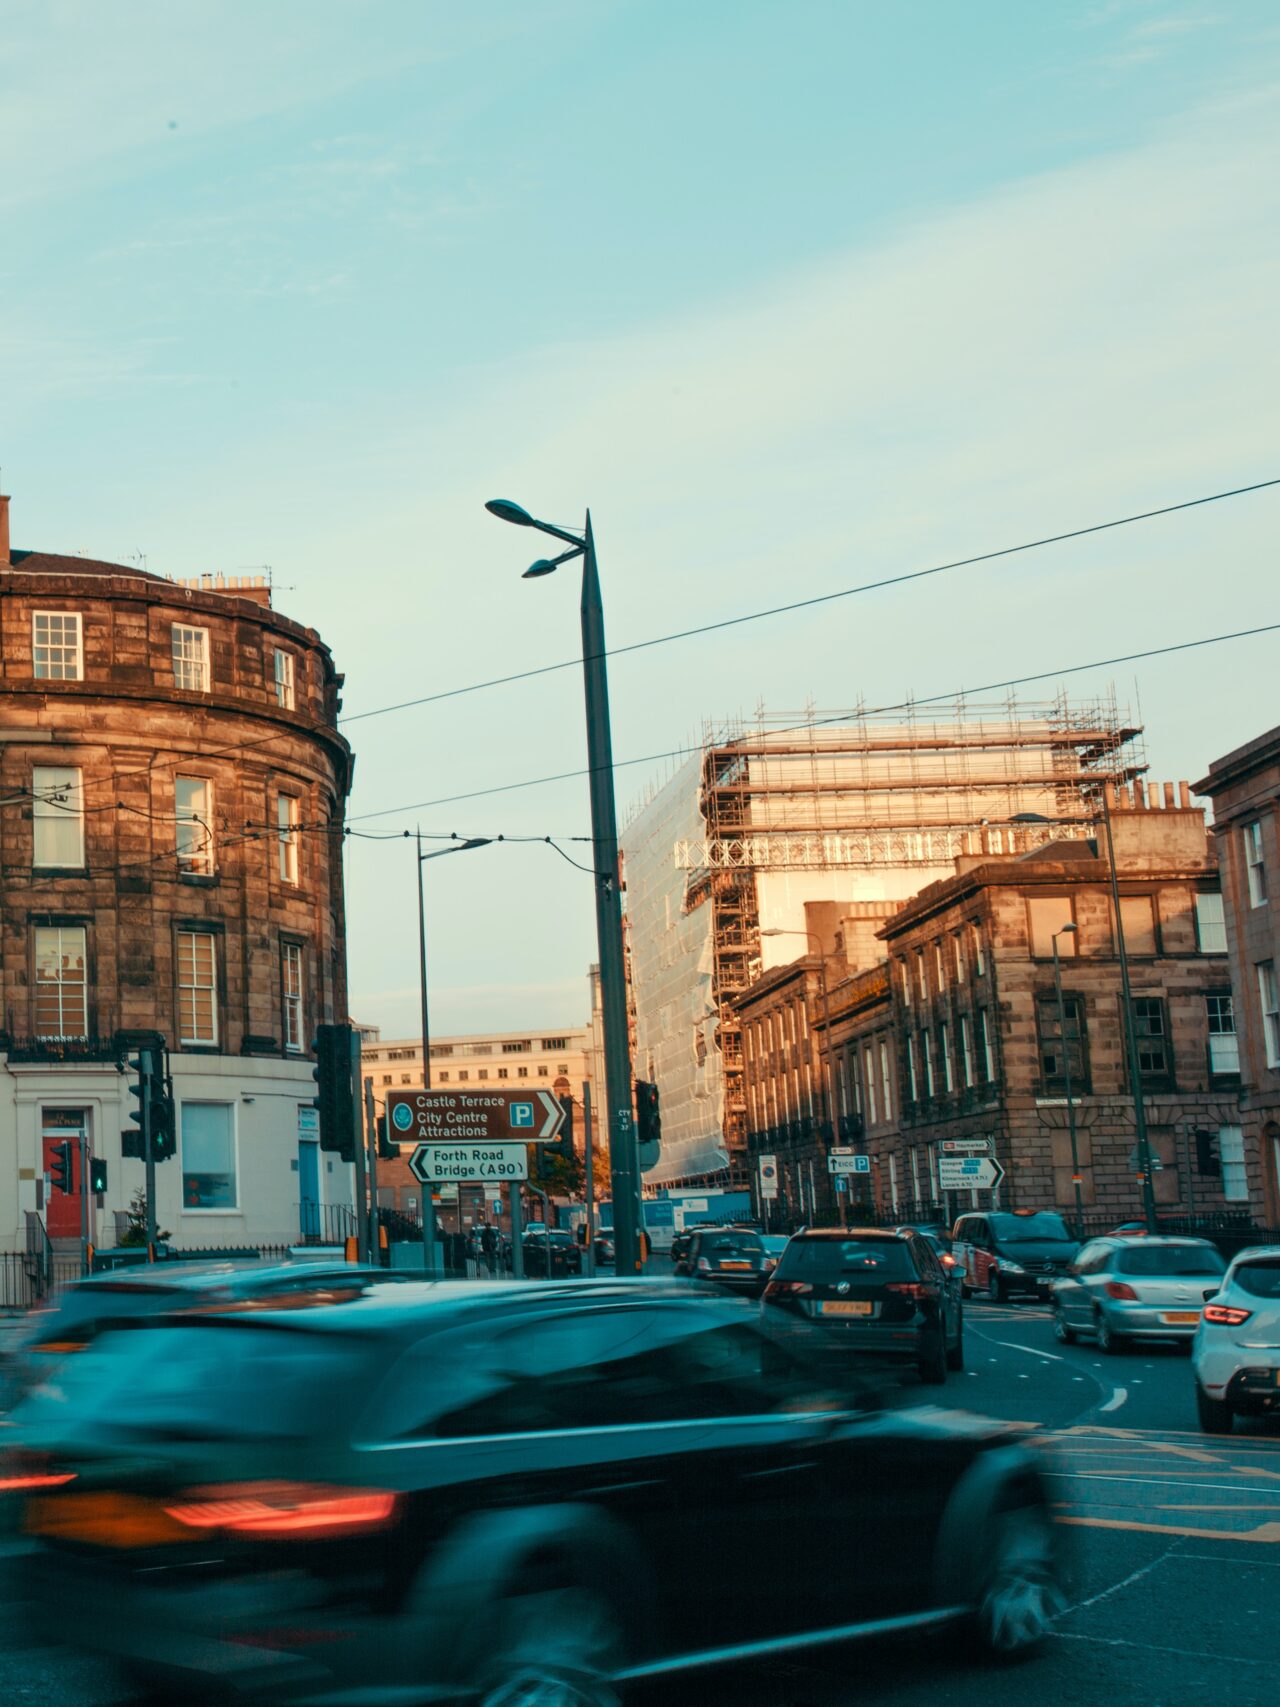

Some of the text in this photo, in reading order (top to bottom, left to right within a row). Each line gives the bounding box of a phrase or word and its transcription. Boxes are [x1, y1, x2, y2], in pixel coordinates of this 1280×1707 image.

[416, 1095, 505, 1108] Castle Terrace
[416, 1111, 488, 1124] City Centre
[516, 1105, 530, 1125] P
[418, 1125, 488, 1137] Attractions
[434, 1150, 504, 1161] Forth Road
[434, 1162, 523, 1177] Bridge (A90)
[857, 1158, 866, 1170] P
